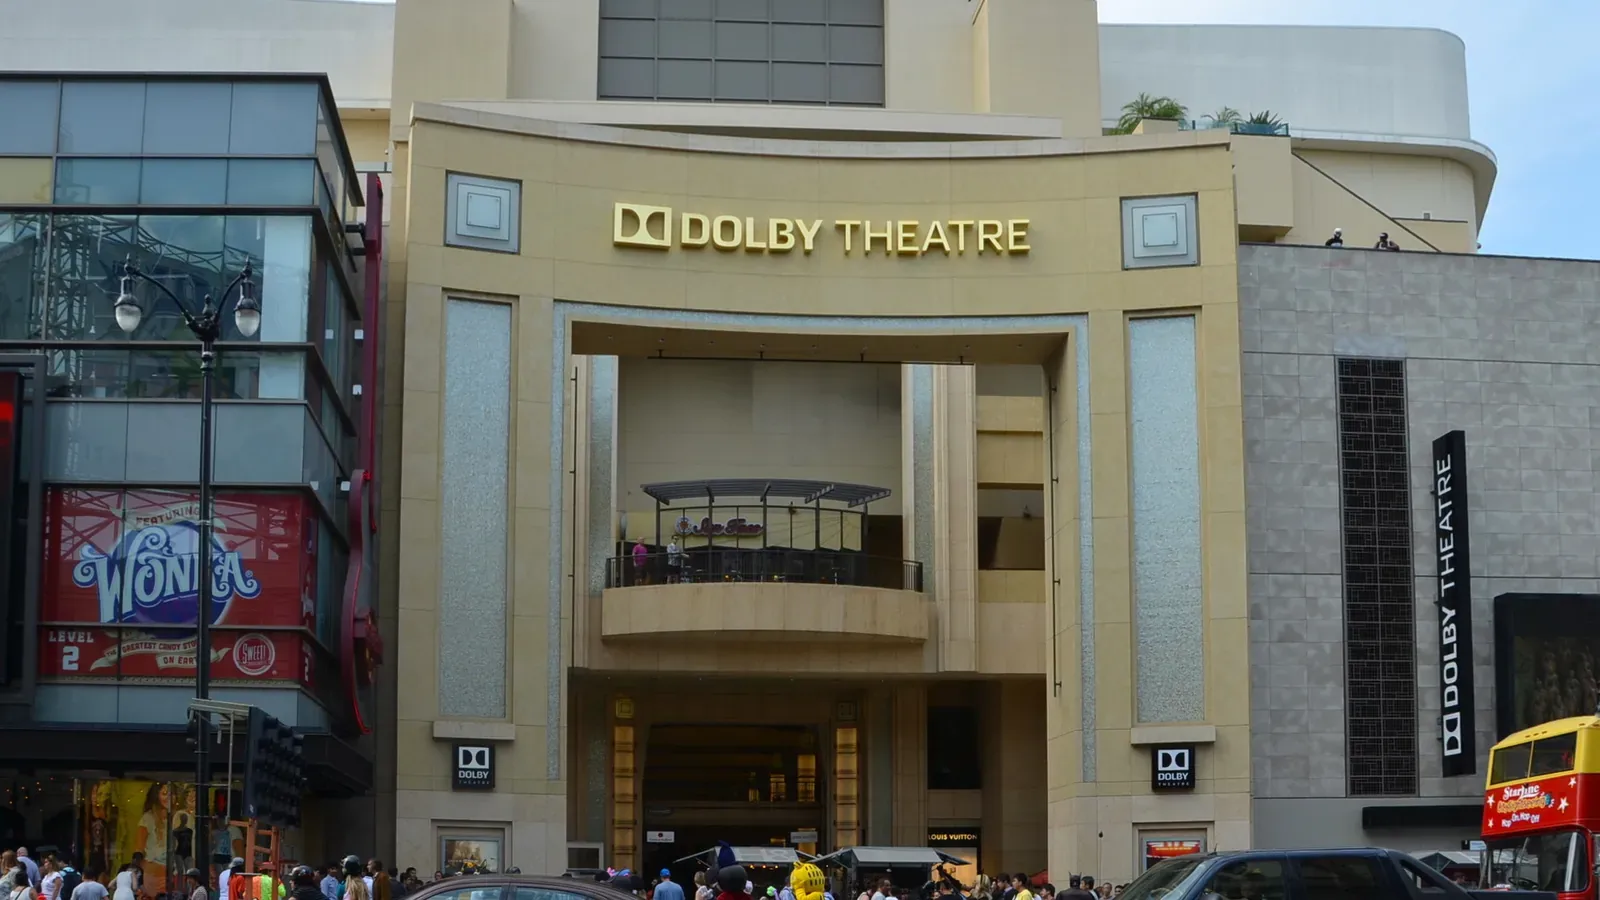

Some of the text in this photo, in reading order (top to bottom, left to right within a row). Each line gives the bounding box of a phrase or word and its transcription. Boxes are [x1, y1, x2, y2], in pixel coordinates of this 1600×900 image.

[681, 212, 1031, 252] DOLBY THEATRE
[136, 503, 200, 527] FEATURING
[1436, 453, 1459, 708] DOLBY THEATRE
[49, 631, 94, 643] LEVEL
[121, 641, 157, 654] GREATEST
[158, 642, 182, 652] CANDY
[62, 646, 79, 671] 2
[163, 656, 174, 665] ON
[458, 770, 489, 779] DOLBY
[1158, 772, 1189, 780] DOLBY
[928, 833, 978, 841] LOUIS VUITTON
